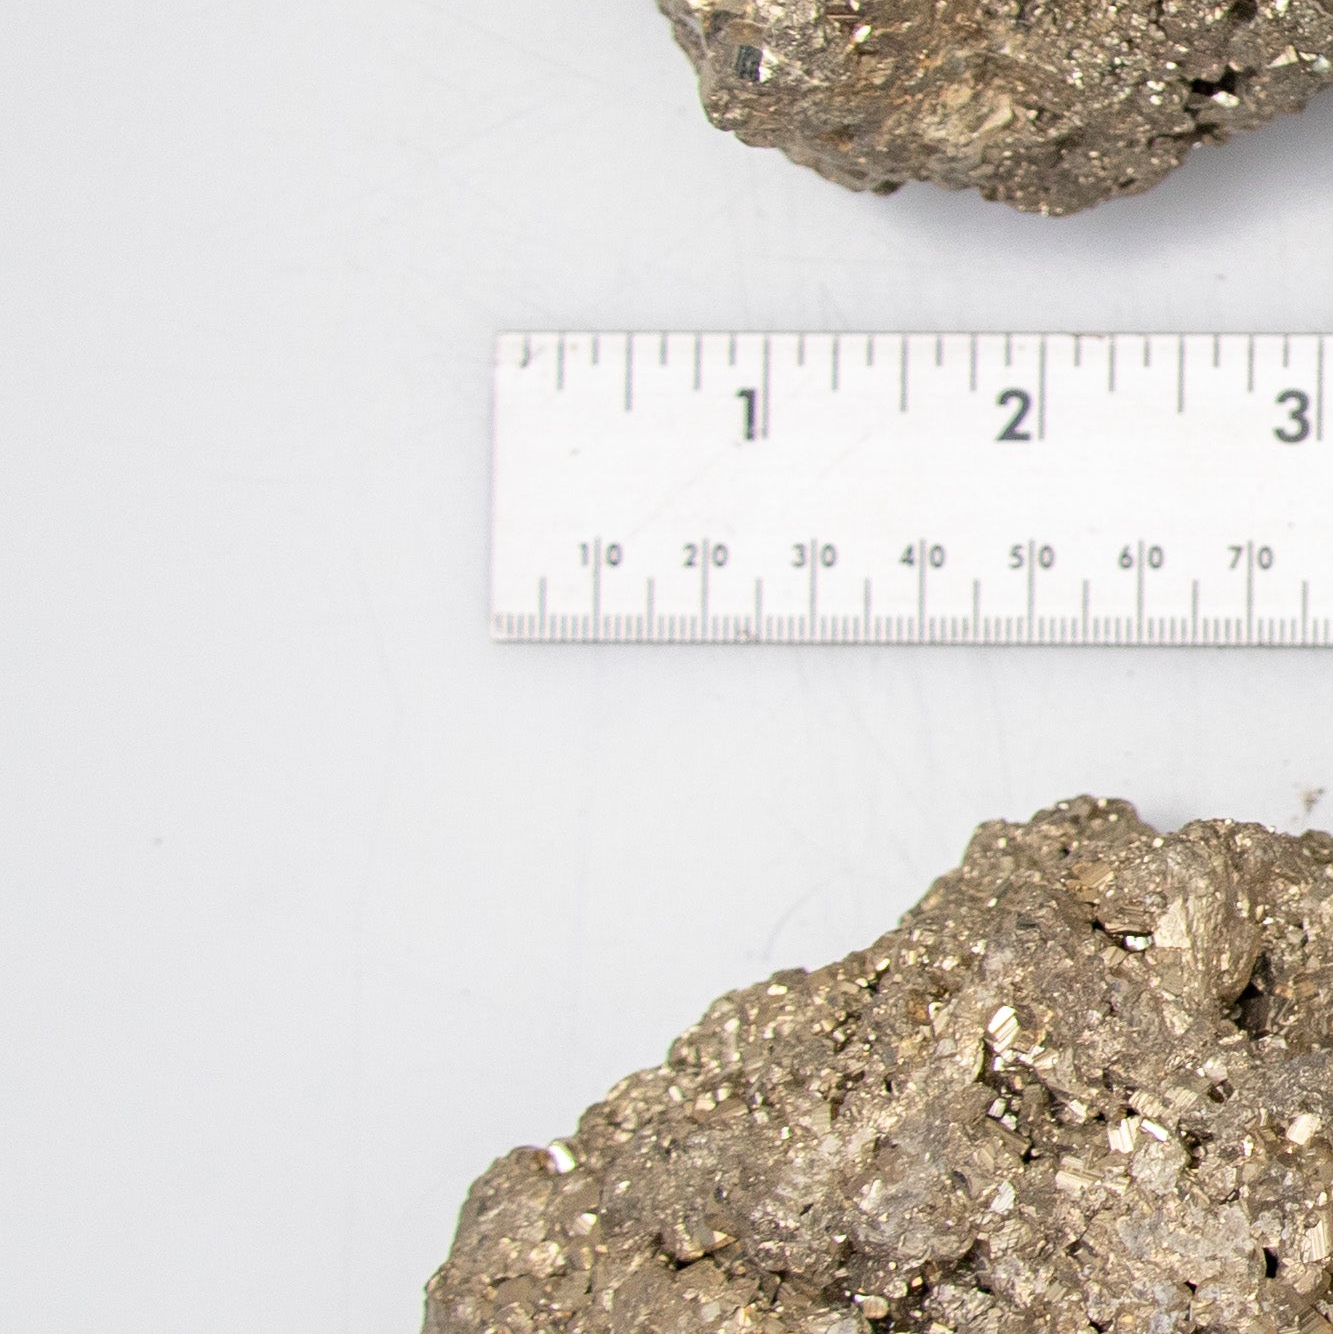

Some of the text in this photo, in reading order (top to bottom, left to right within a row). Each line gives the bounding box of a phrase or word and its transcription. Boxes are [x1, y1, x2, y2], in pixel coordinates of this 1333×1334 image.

[737, 388, 756, 441] 1
[996, 388, 1032, 442] 2
[1274, 389, 1311, 444] 3
[580, 542, 623, 568] 10
[683, 543, 729, 569] 20
[792, 543, 837, 569] 30
[899, 544, 945, 570] 40
[1009, 544, 1055, 570] 50
[1118, 545, 1164, 571] 60
[1228, 546, 1274, 572] 70
